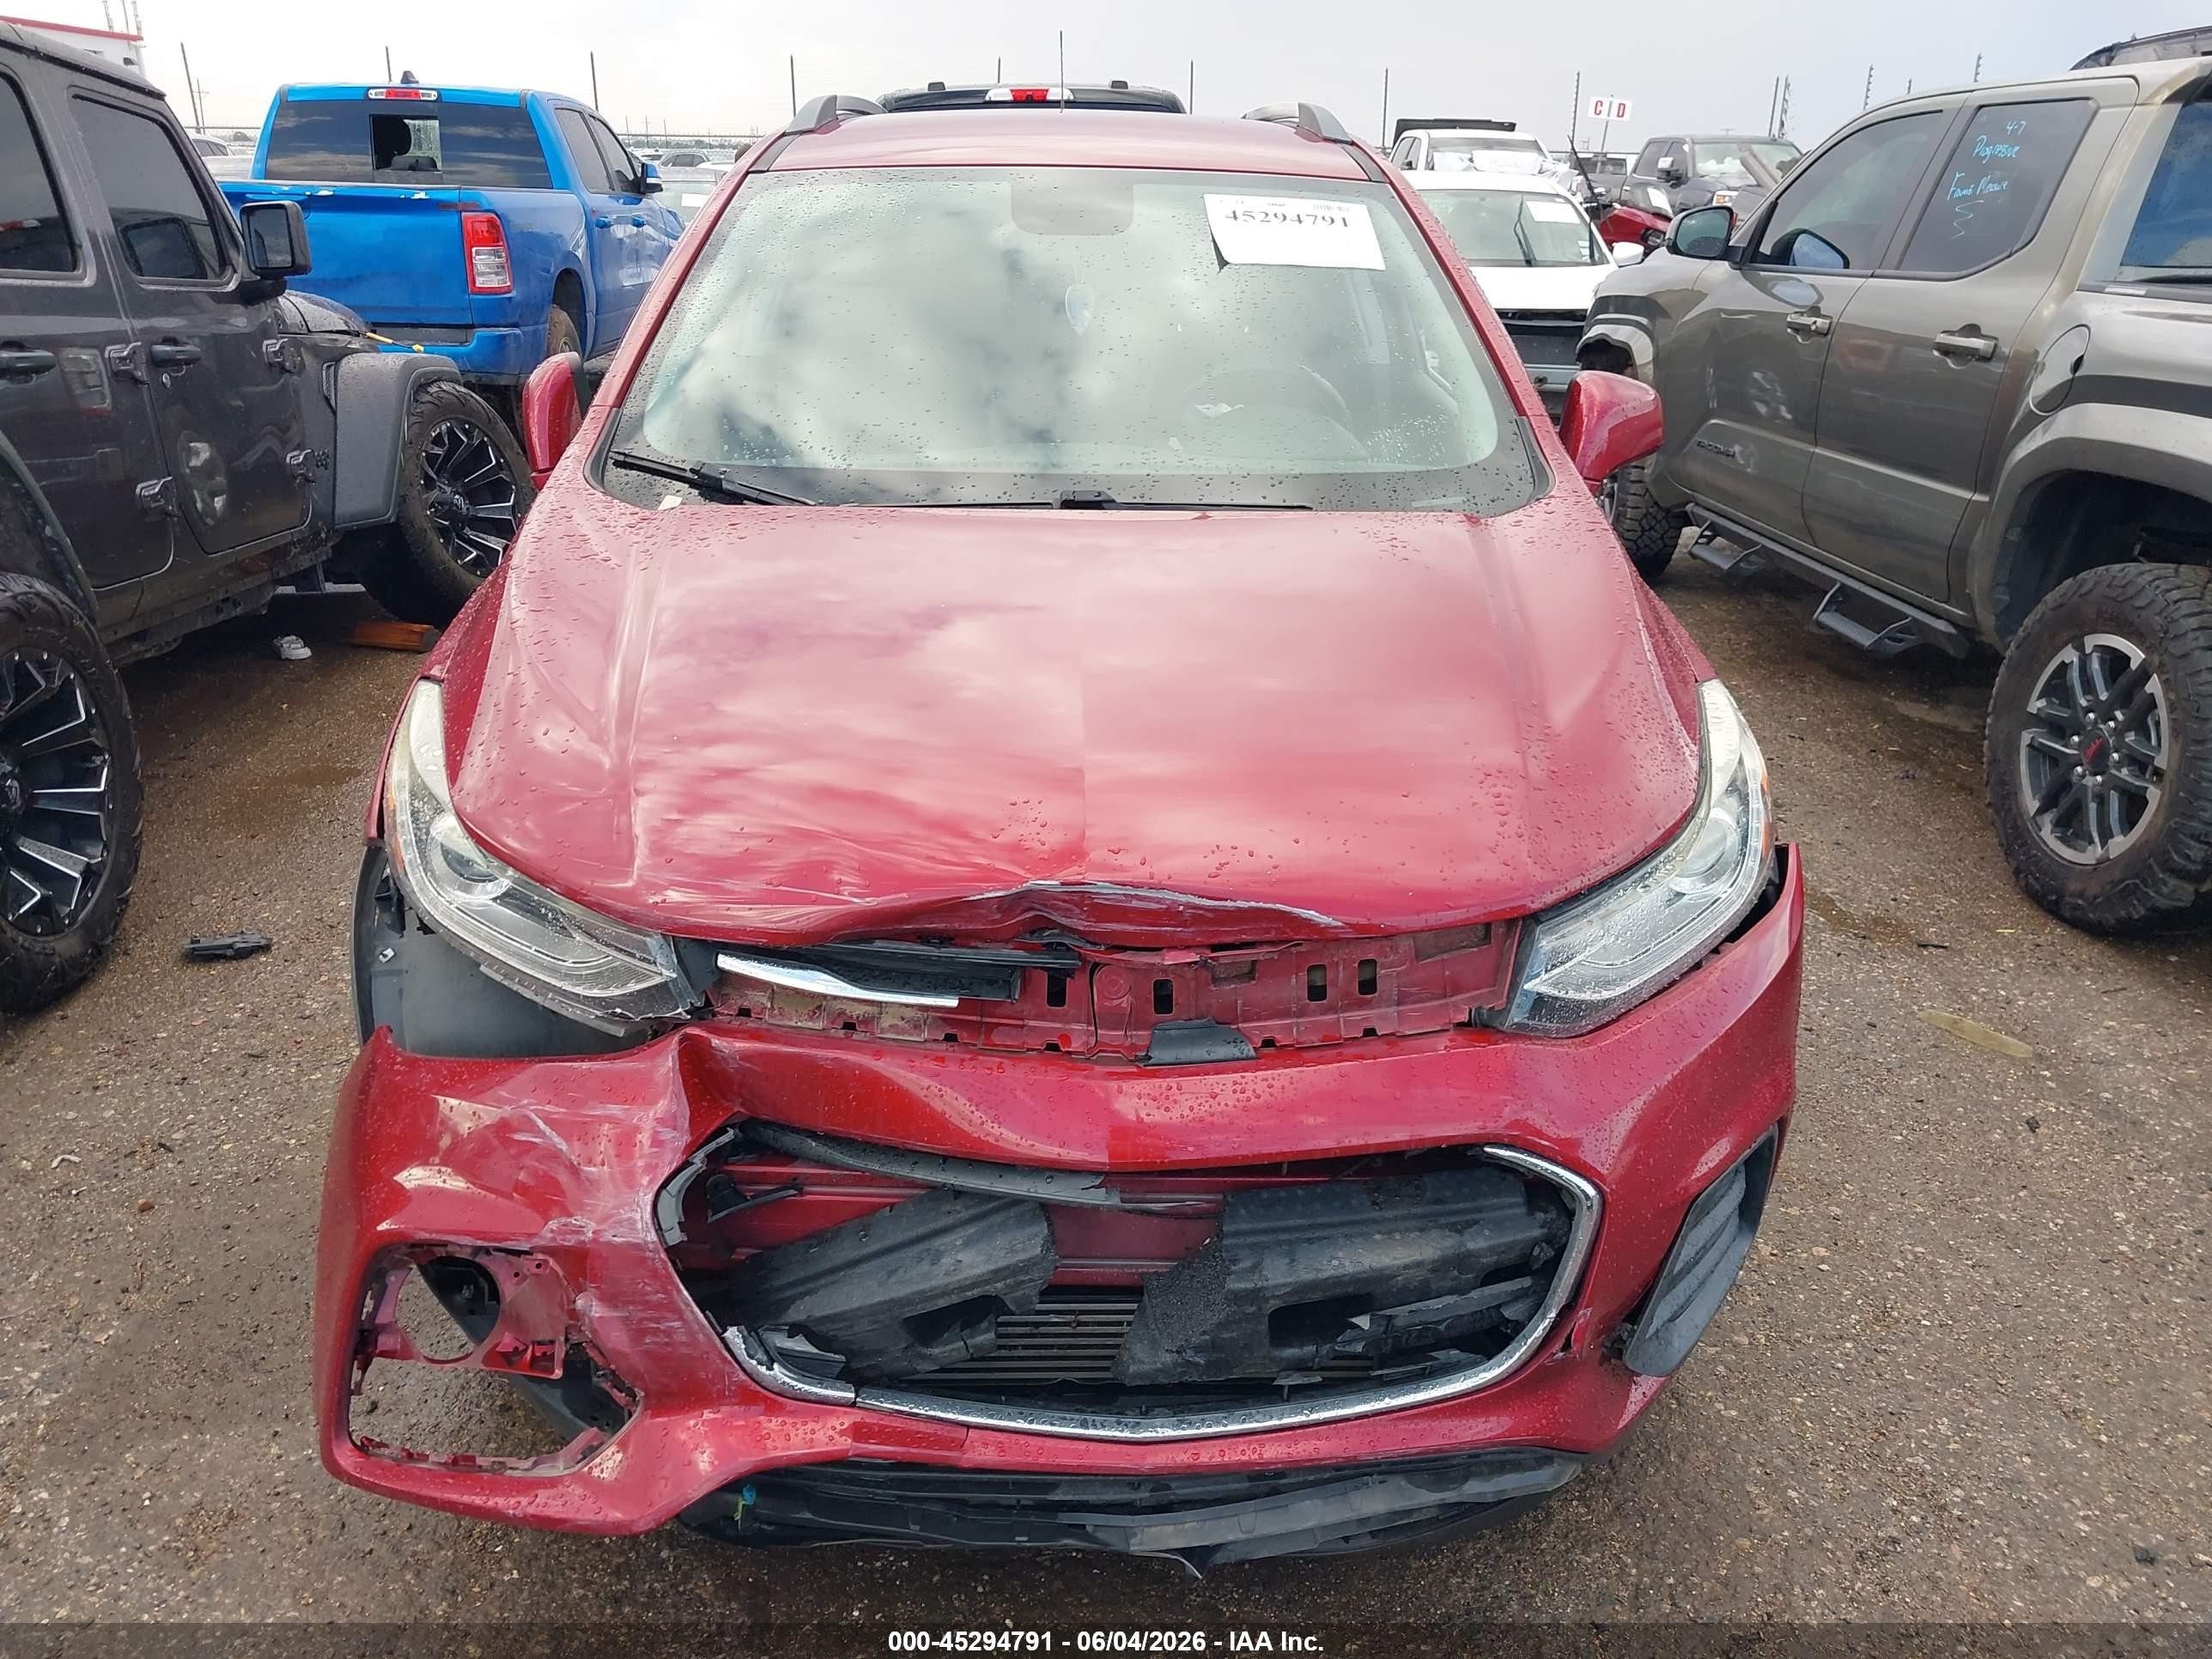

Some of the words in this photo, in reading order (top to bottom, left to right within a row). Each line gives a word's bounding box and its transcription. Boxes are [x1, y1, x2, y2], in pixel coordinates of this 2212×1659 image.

[1594, 100, 1603, 116] C
[1616, 102, 1626, 118] D
[1224, 210, 1349, 228] 45294791
